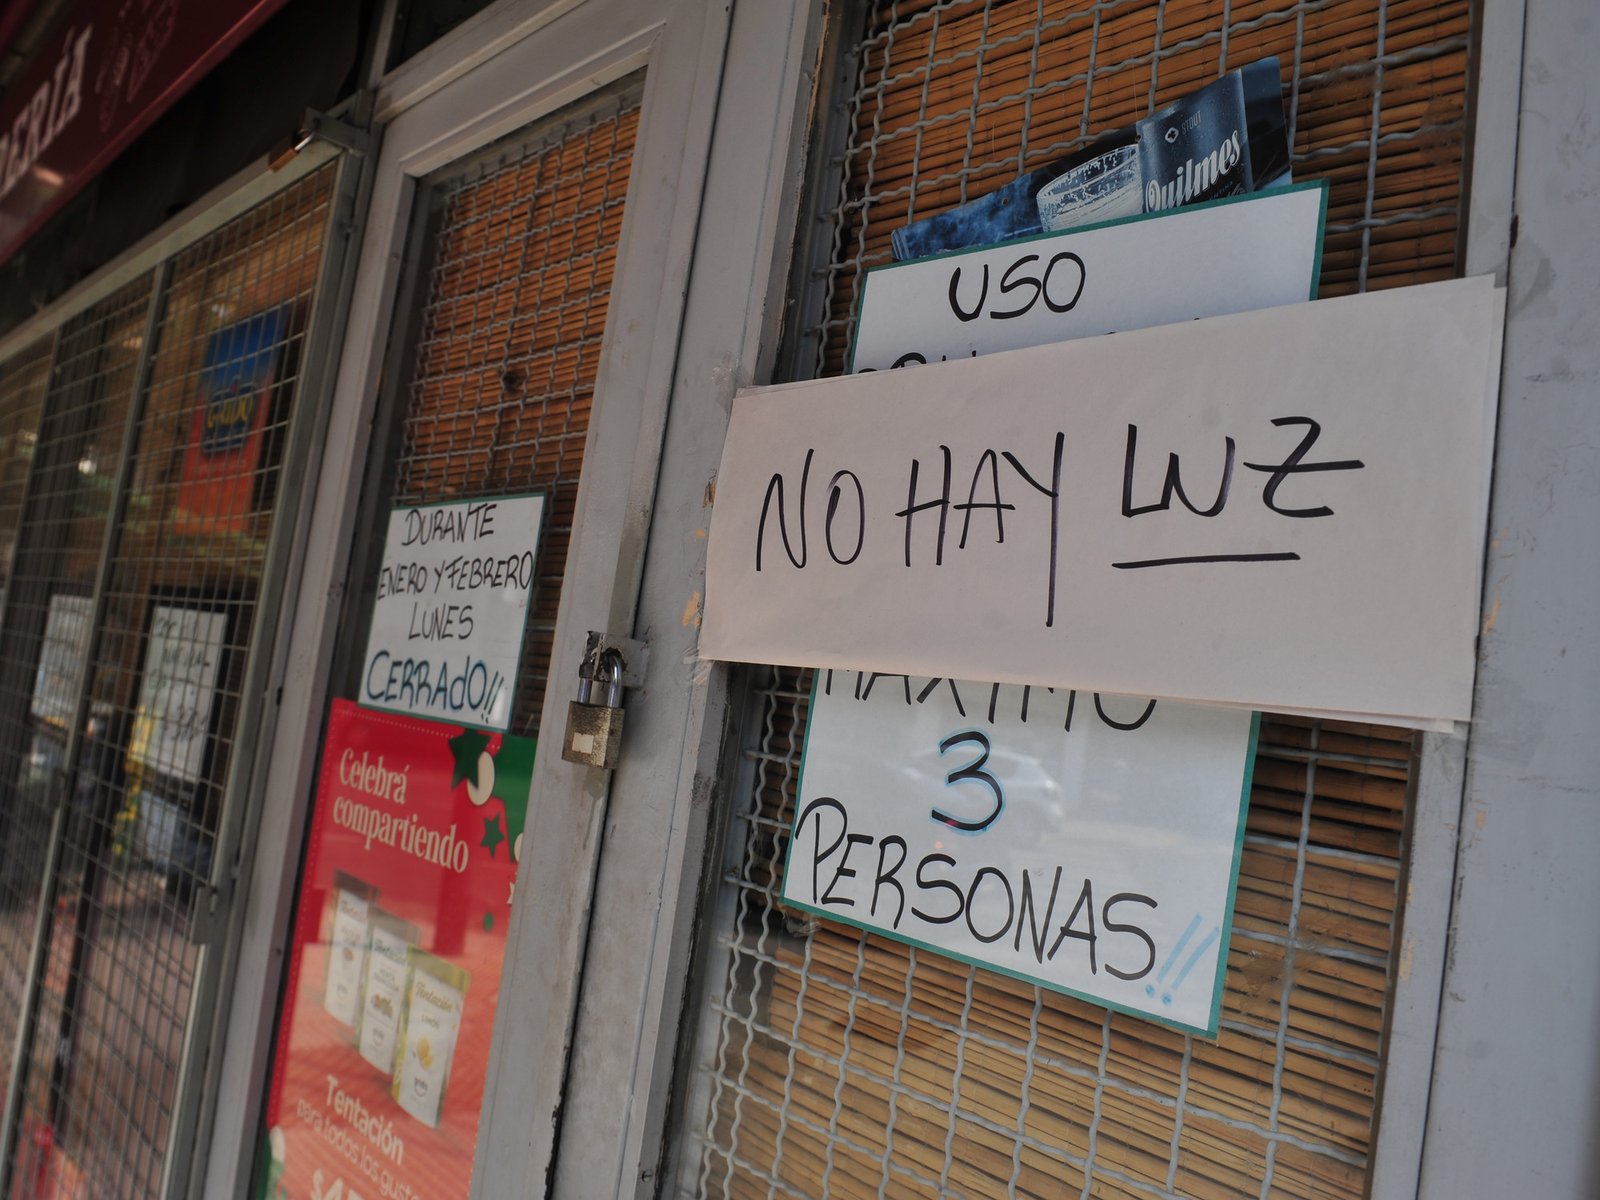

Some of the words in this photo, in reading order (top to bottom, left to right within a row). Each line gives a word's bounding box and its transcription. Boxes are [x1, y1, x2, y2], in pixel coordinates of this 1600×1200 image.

[1145, 129, 1240, 213] Quilmes
[948, 251, 1086, 322] USO
[401, 503, 498, 547] DURANTE
[755, 448, 865, 572] NO
[895, 432, 1065, 627] HAY
[1121, 416, 1366, 519] LUZ
[377, 562, 428, 600] ENERO
[433, 559, 447, 594] Y
[445, 550, 535, 591] FEBRERO
[408, 602, 474, 641] LUNES
[339, 746, 412, 805] Celebrá
[930, 729, 1005, 833] 3
[332, 796, 470, 874] compartiendo
[296, 1097, 323, 1133] para
[322, 1115, 360, 1165] todos
[360, 1144, 380, 1183] los
[325, 1073, 404, 1166] Tentación
